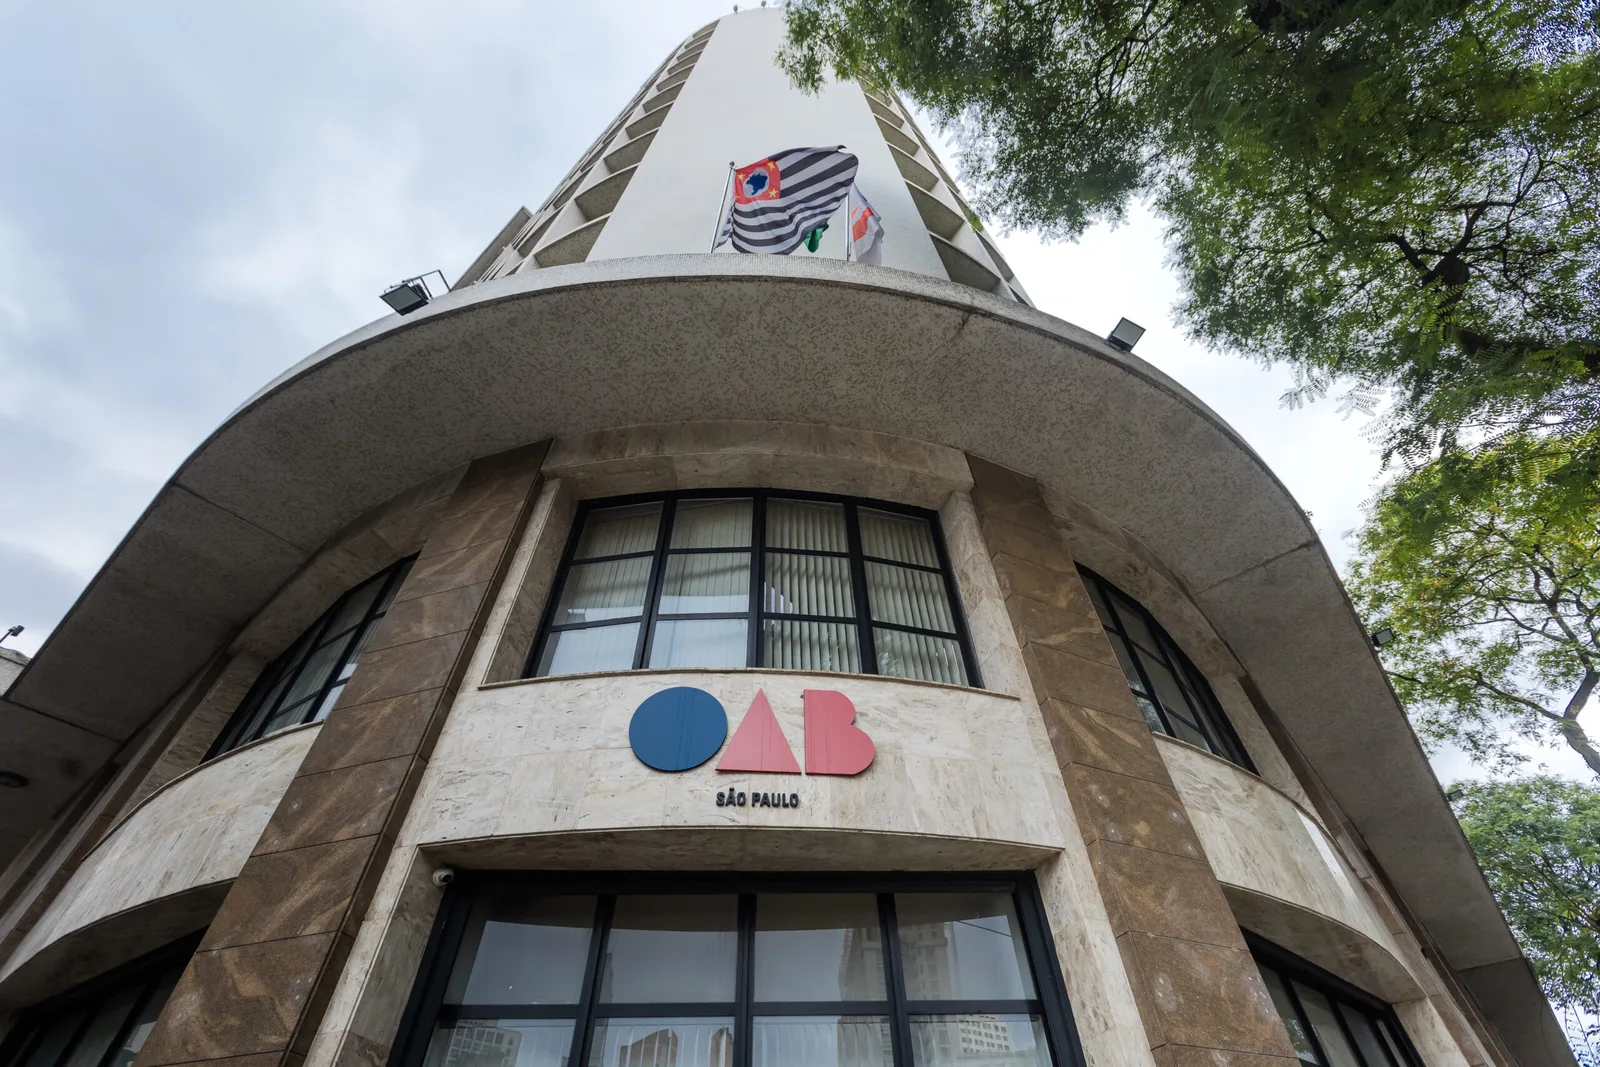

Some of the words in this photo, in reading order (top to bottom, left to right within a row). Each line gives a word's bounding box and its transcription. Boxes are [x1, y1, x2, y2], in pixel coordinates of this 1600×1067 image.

[629, 686, 875, 776] OAB
[716, 787, 746, 807] SÃO
[752, 792, 799, 808] PAULO
